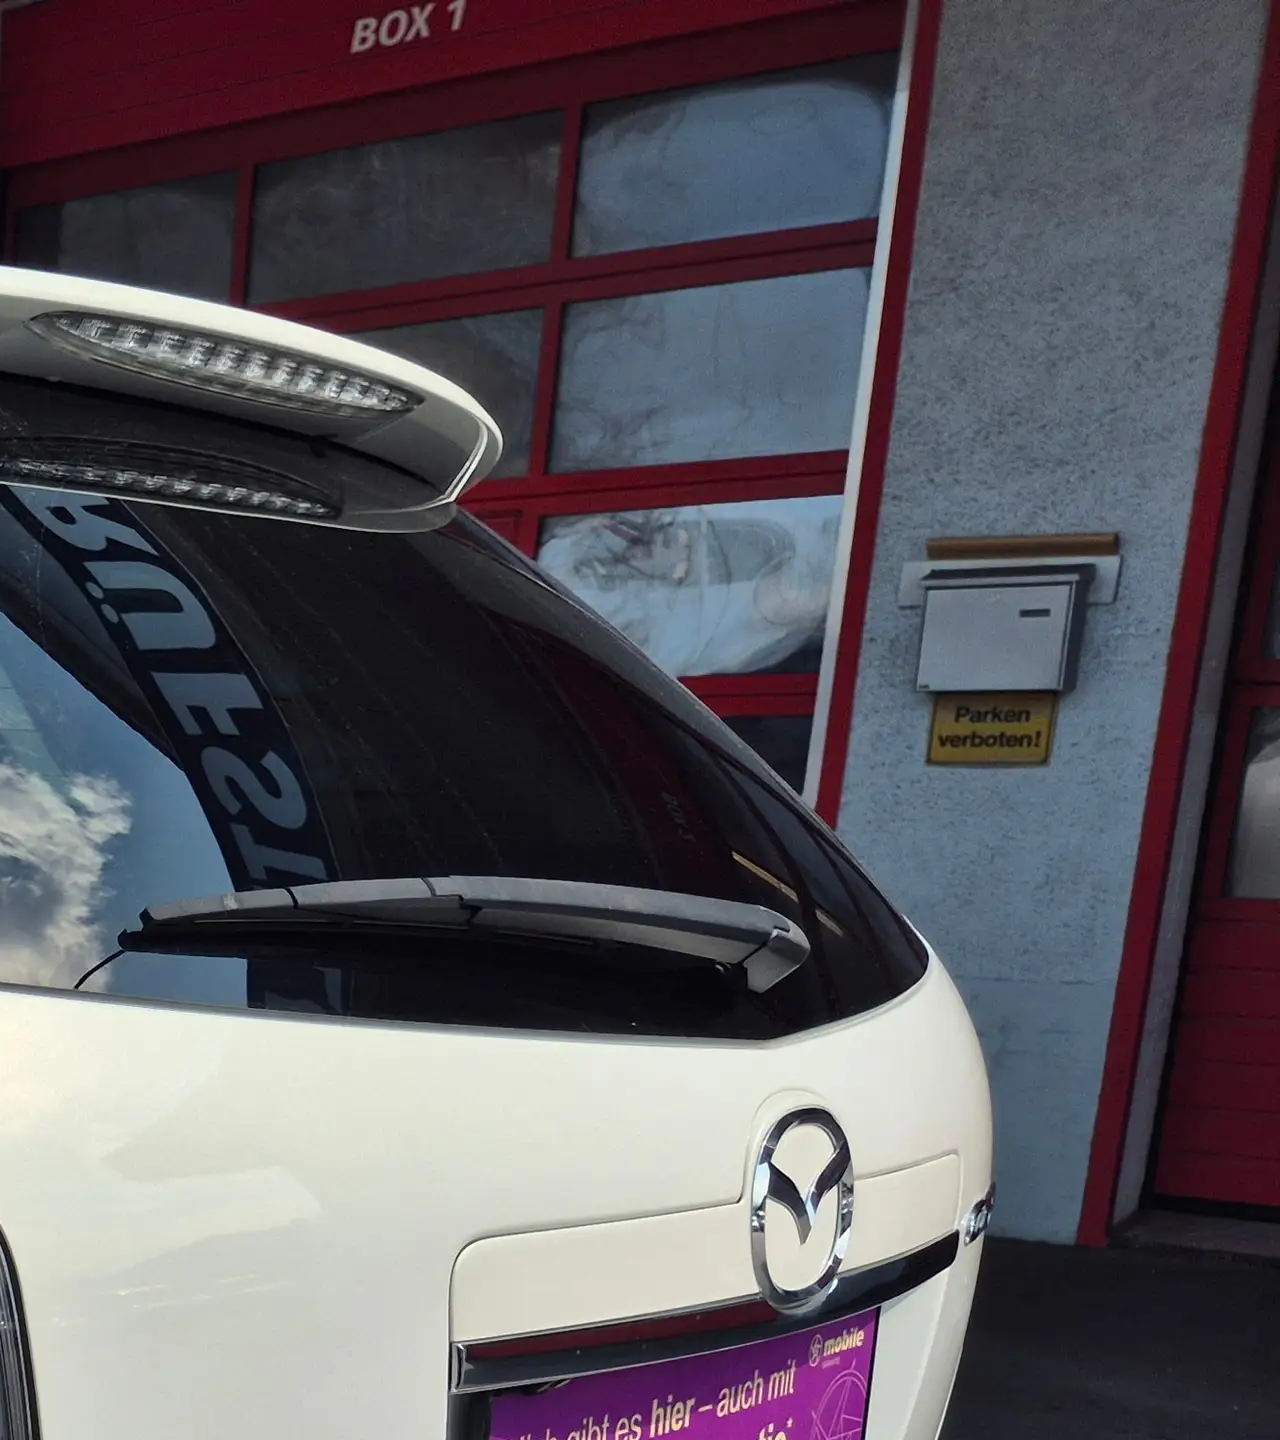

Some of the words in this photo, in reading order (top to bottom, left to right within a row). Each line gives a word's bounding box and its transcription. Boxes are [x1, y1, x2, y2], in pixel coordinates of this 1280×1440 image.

[350, 4, 435, 54] BOX
[446, 0, 467, 31] 1
[953, 705, 1031, 724] Parken
[938, 730, 1041, 749] verboten!
[823, 1326, 864, 1356] mobile
[649, 1394, 692, 1438] hier
[716, 1380, 765, 1419] auch
[768, 1360, 796, 1401] mit
